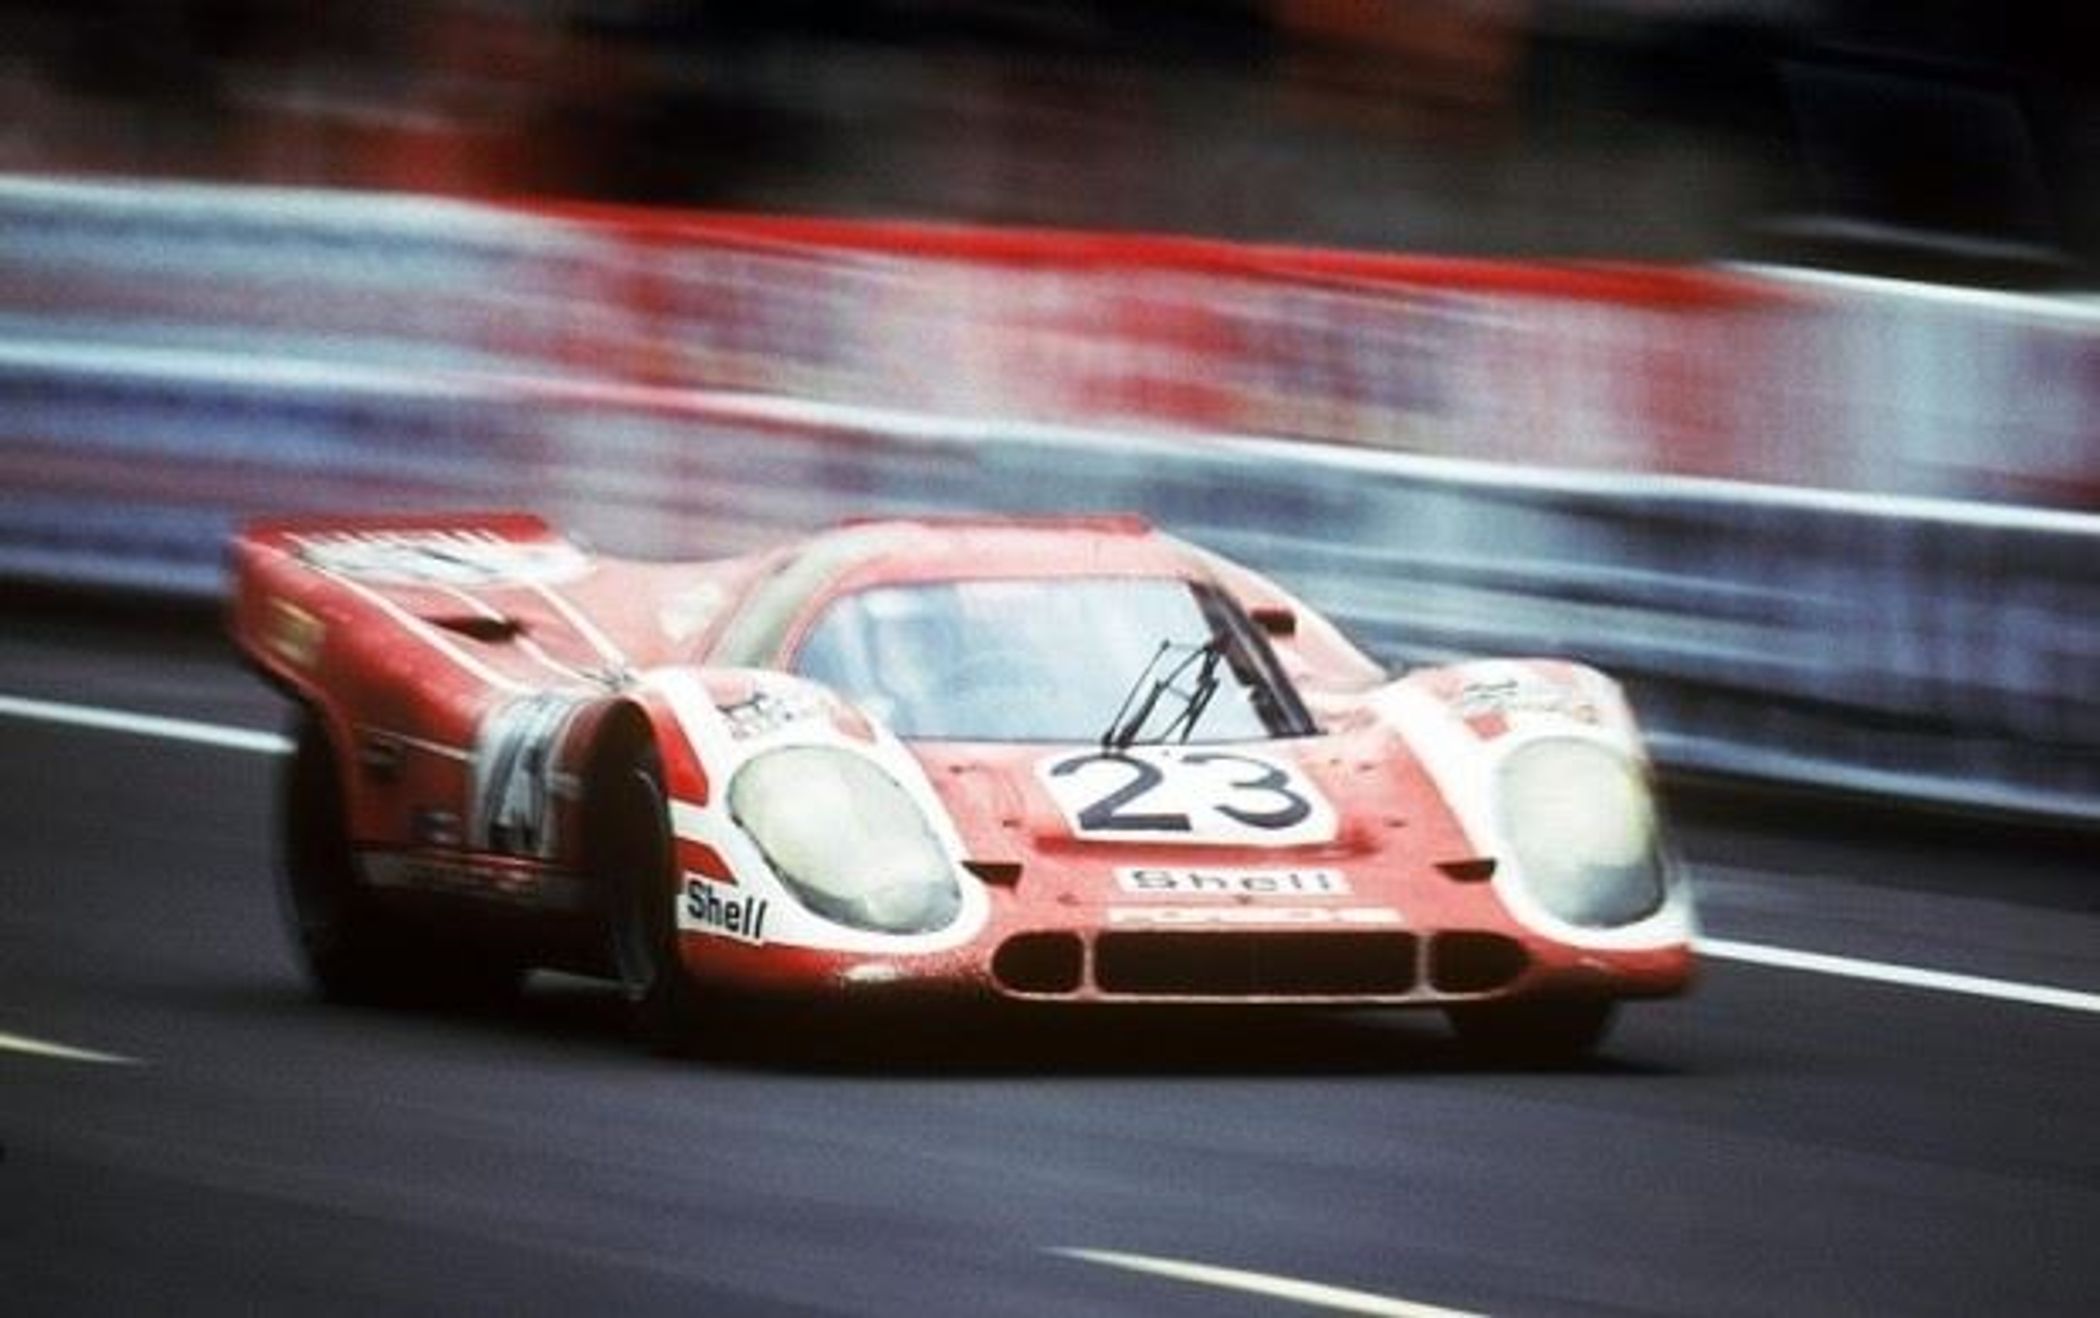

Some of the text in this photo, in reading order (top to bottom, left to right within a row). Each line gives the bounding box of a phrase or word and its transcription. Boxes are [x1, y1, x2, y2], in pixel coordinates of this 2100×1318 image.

[1050, 753, 1312, 831] 23
[687, 879, 767, 938] Shell
[1131, 869, 1331, 891] Shell
